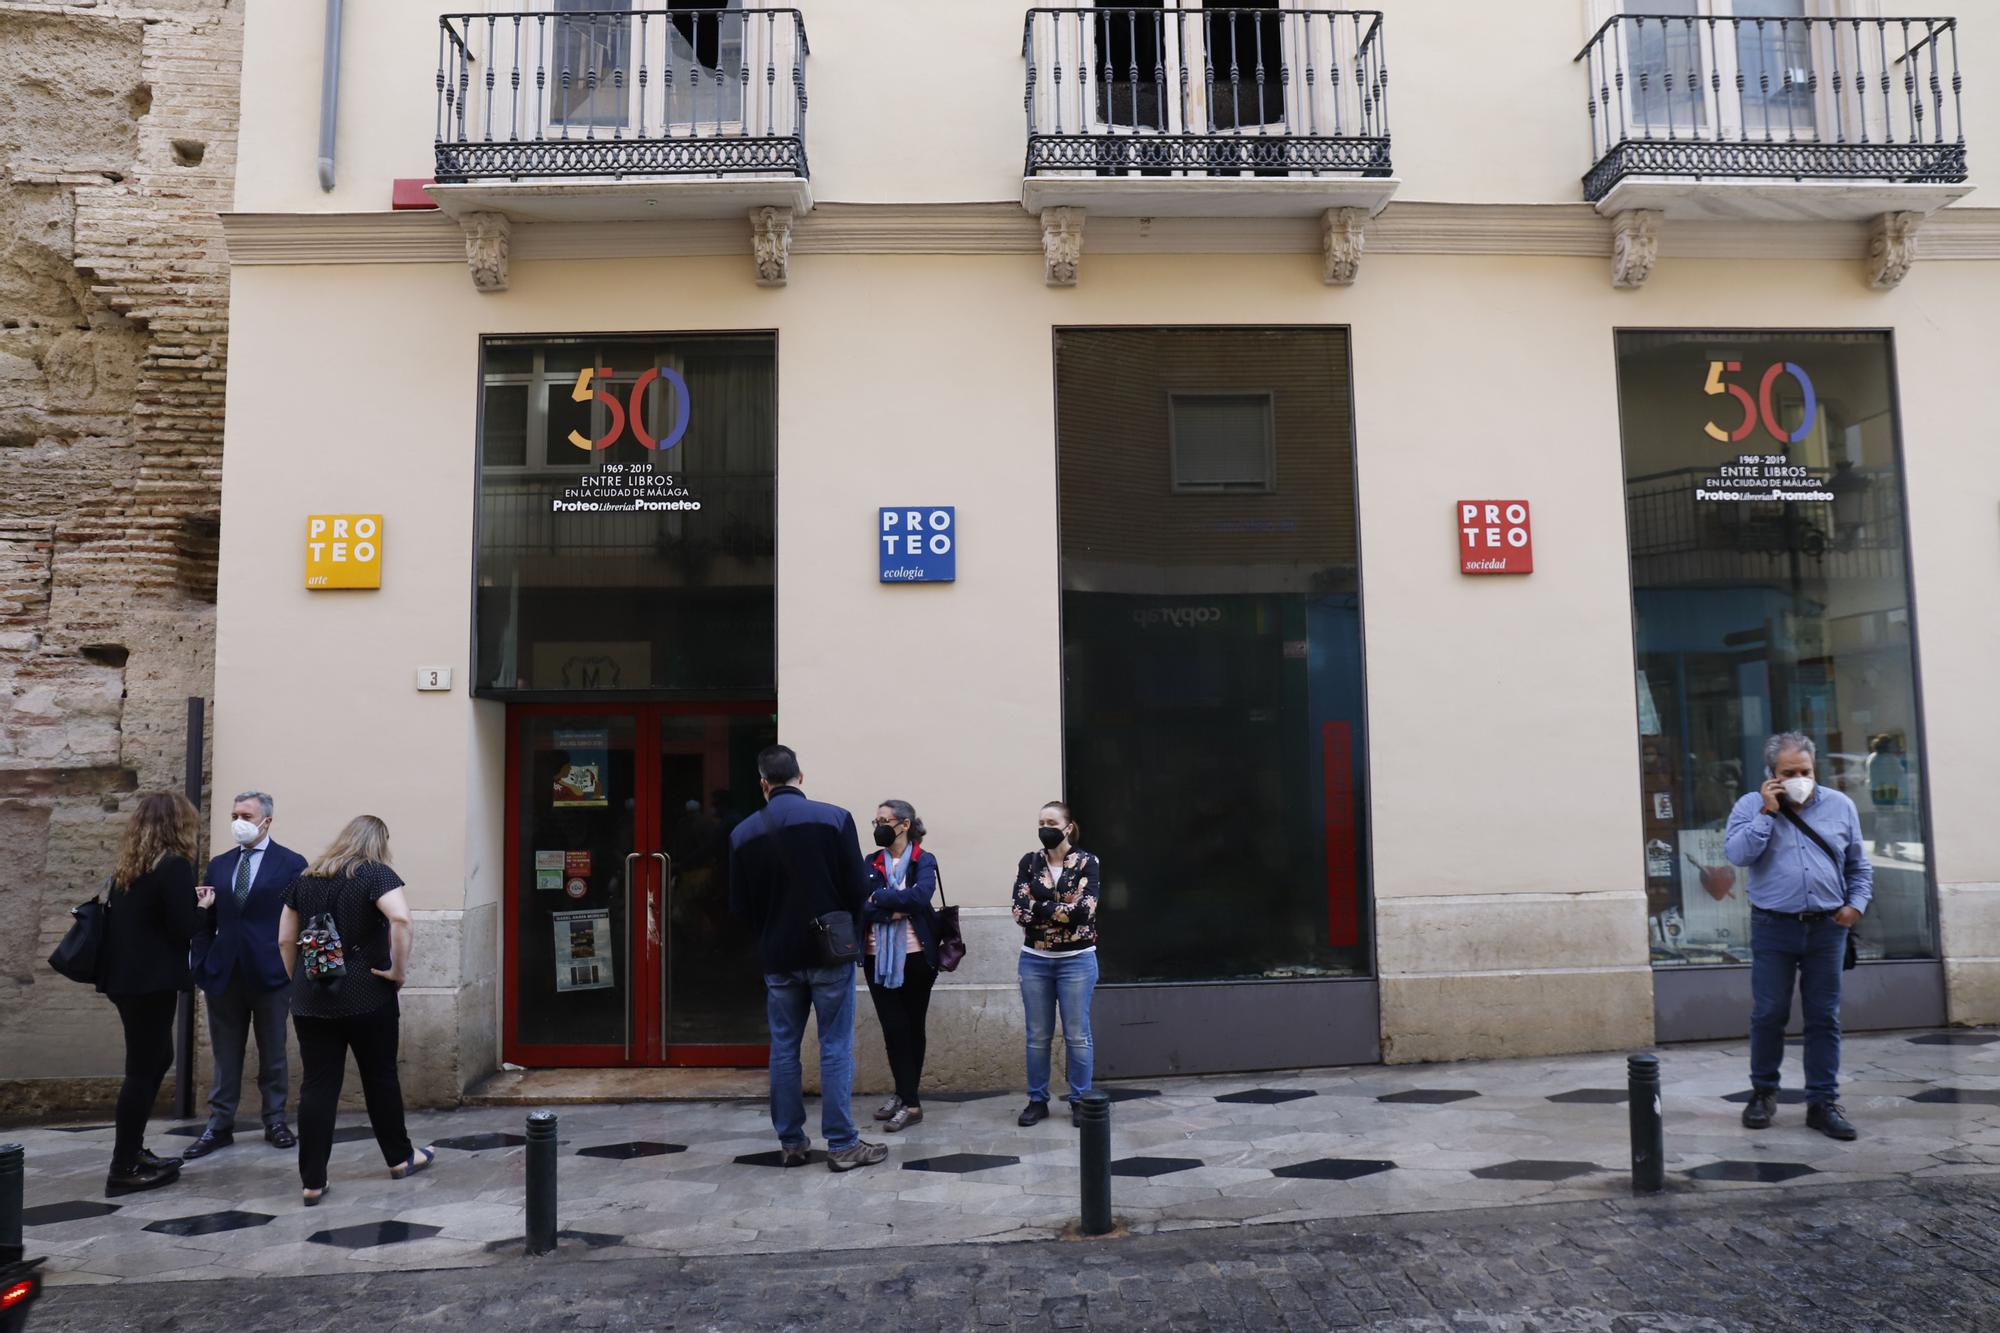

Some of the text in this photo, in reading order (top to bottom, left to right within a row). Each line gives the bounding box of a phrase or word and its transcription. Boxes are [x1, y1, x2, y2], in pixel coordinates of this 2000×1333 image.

[567, 366, 690, 451] 50
[1703, 361, 1817, 443] 50
[1720, 466, 1807, 477] ENTRE LIBROS
[581, 475, 673, 487] ENTRE LIBROS
[1706, 477, 1822, 487] EN LA CIUDAD DE MÁLAGA
[565, 486, 689, 498] EN LA CIUDAD DE MÁLAGA
[1696, 489, 1740, 500] Proteo
[1772, 489, 1835, 500] Prometeo
[553, 500, 599, 512] Proteo
[635, 499, 701, 511] Prometeo
[883, 510, 951, 531] PRO
[1462, 504, 1527, 524] PRO
[310, 518, 376, 539] PRO
[882, 534, 951, 555] TEO
[1463, 527, 1528, 548] TEO
[309, 541, 375, 562] TEO
[1465, 557, 1506, 570] sociedad
[308, 575, 328, 585] arte
[430, 671, 438, 686] 3
